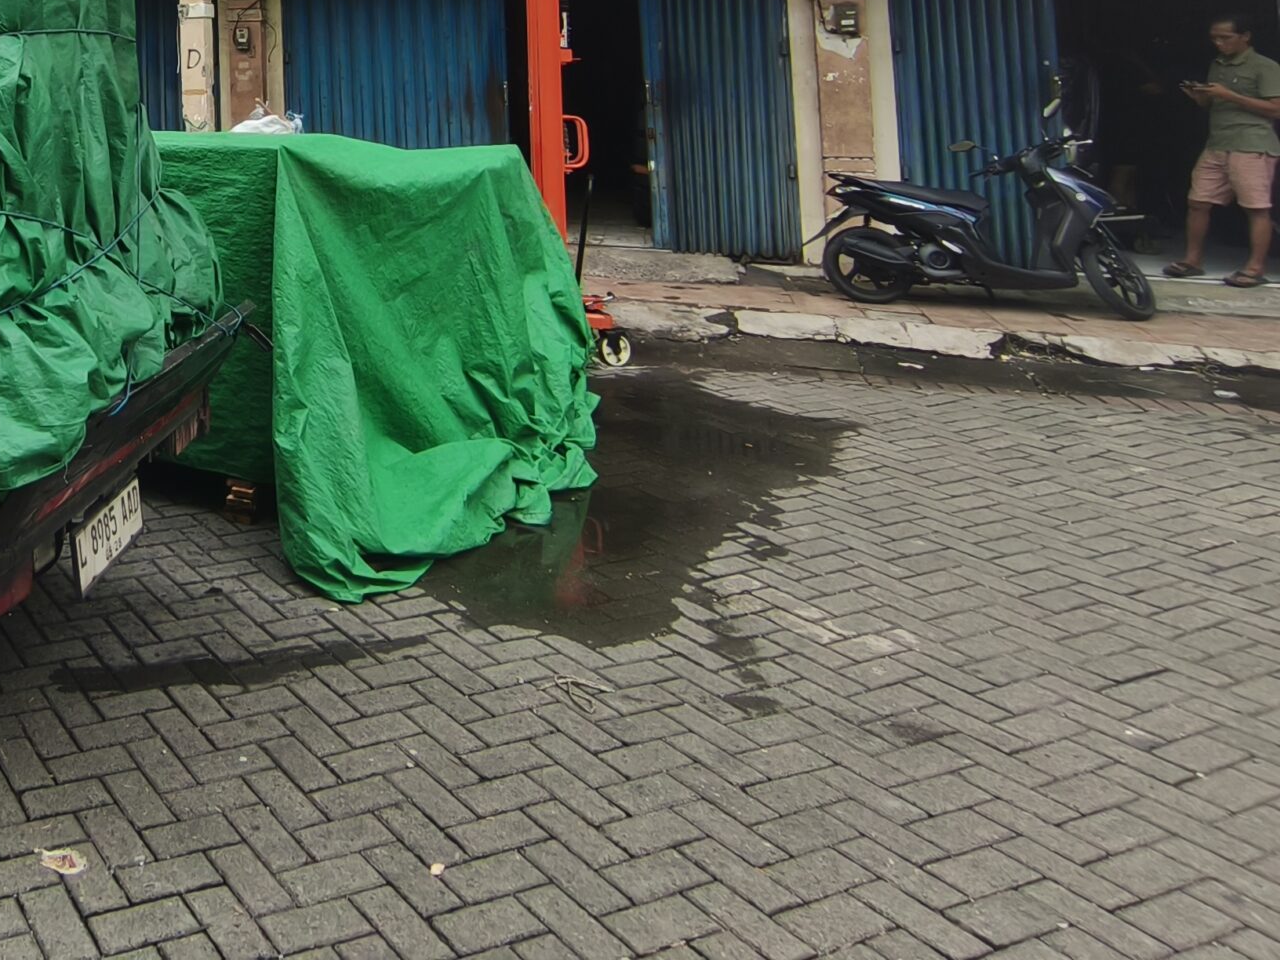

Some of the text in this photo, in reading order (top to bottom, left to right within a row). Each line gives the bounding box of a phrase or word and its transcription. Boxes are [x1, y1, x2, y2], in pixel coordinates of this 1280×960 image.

[187, 48, 201, 69] D
[78, 539, 87, 568] L
[91, 505, 117, 555] 8985
[121, 485, 138, 526] AAD
